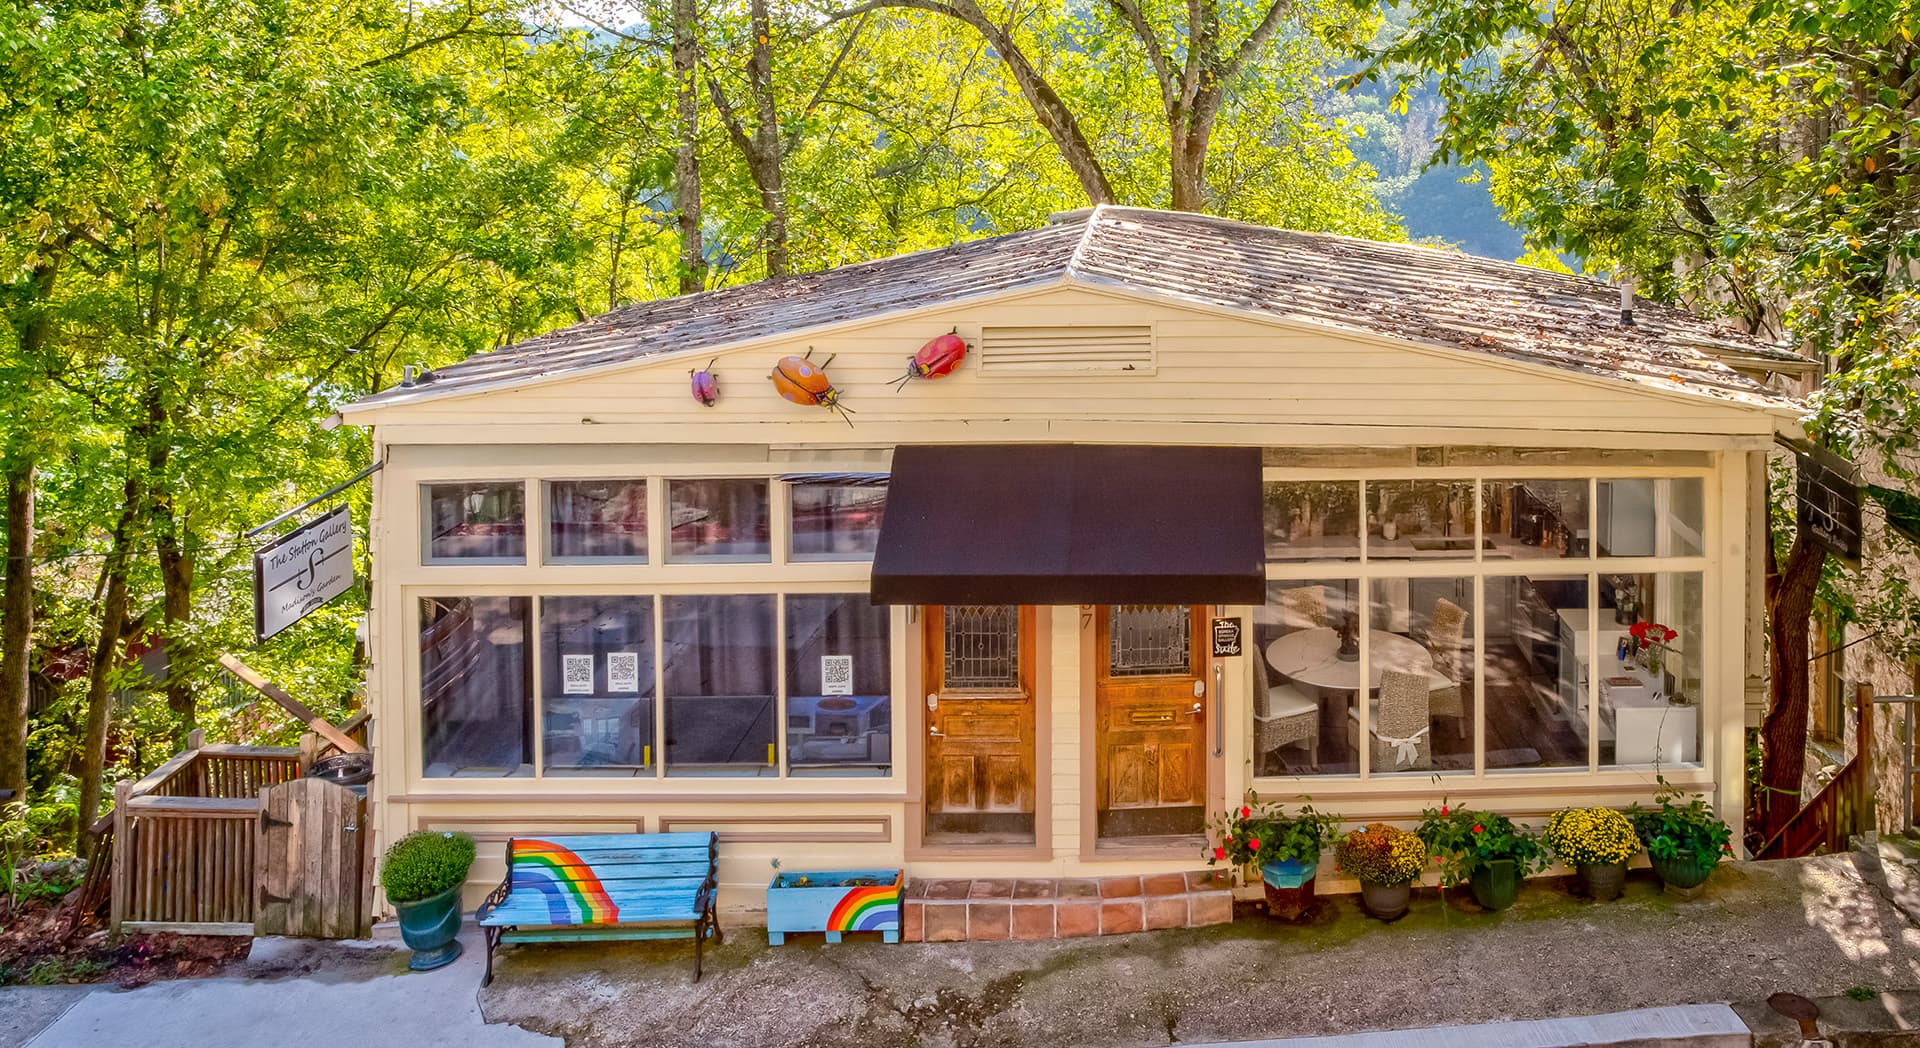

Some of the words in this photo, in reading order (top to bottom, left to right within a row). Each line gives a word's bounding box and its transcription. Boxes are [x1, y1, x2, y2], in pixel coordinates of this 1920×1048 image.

[270, 554, 287, 570] The
[319, 521, 347, 543] Gallery
[316, 574, 342, 592] Garden
[1214, 643, 1240, 654] Suite
